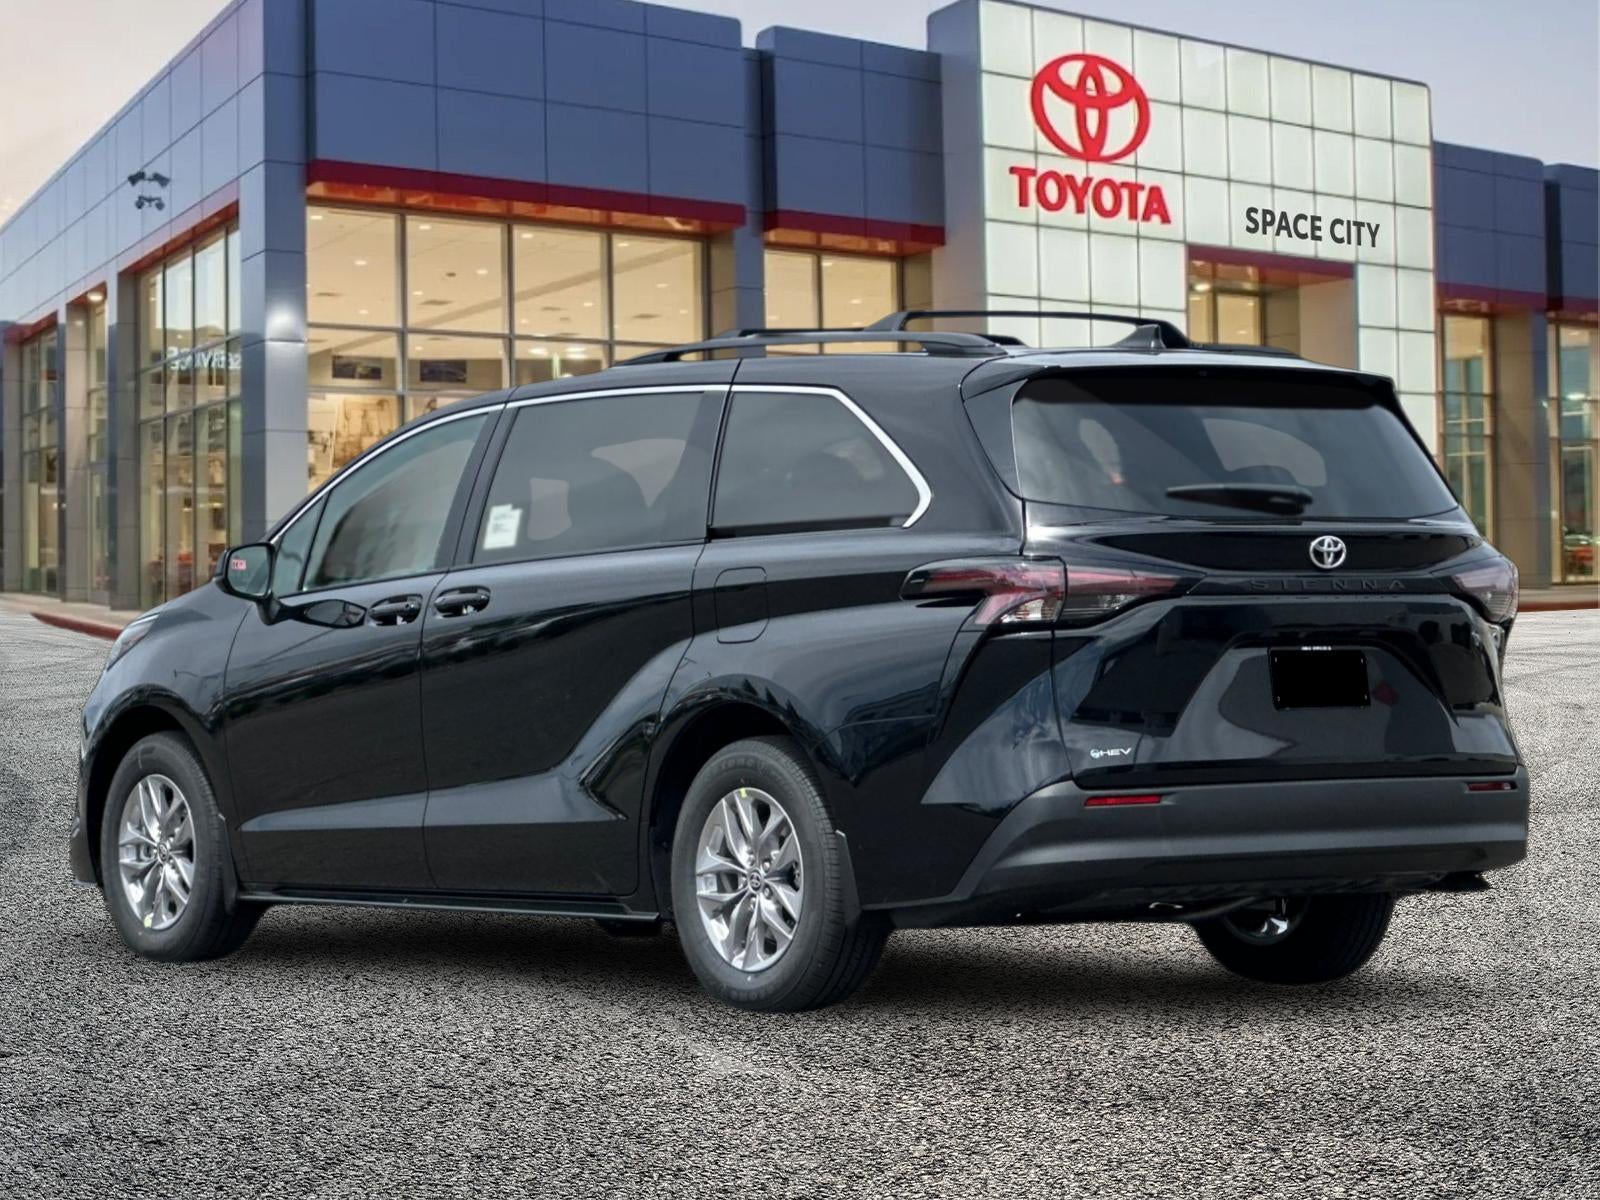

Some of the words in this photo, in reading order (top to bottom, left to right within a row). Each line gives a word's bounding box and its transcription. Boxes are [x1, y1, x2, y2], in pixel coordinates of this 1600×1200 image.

[1009, 166, 1171, 224] TOYOTA
[1245, 206, 1322, 242] SPACE
[1329, 218, 1381, 248] CITY
[1250, 578, 1406, 591] SIENNA
[1100, 747, 1132, 757] HEV
